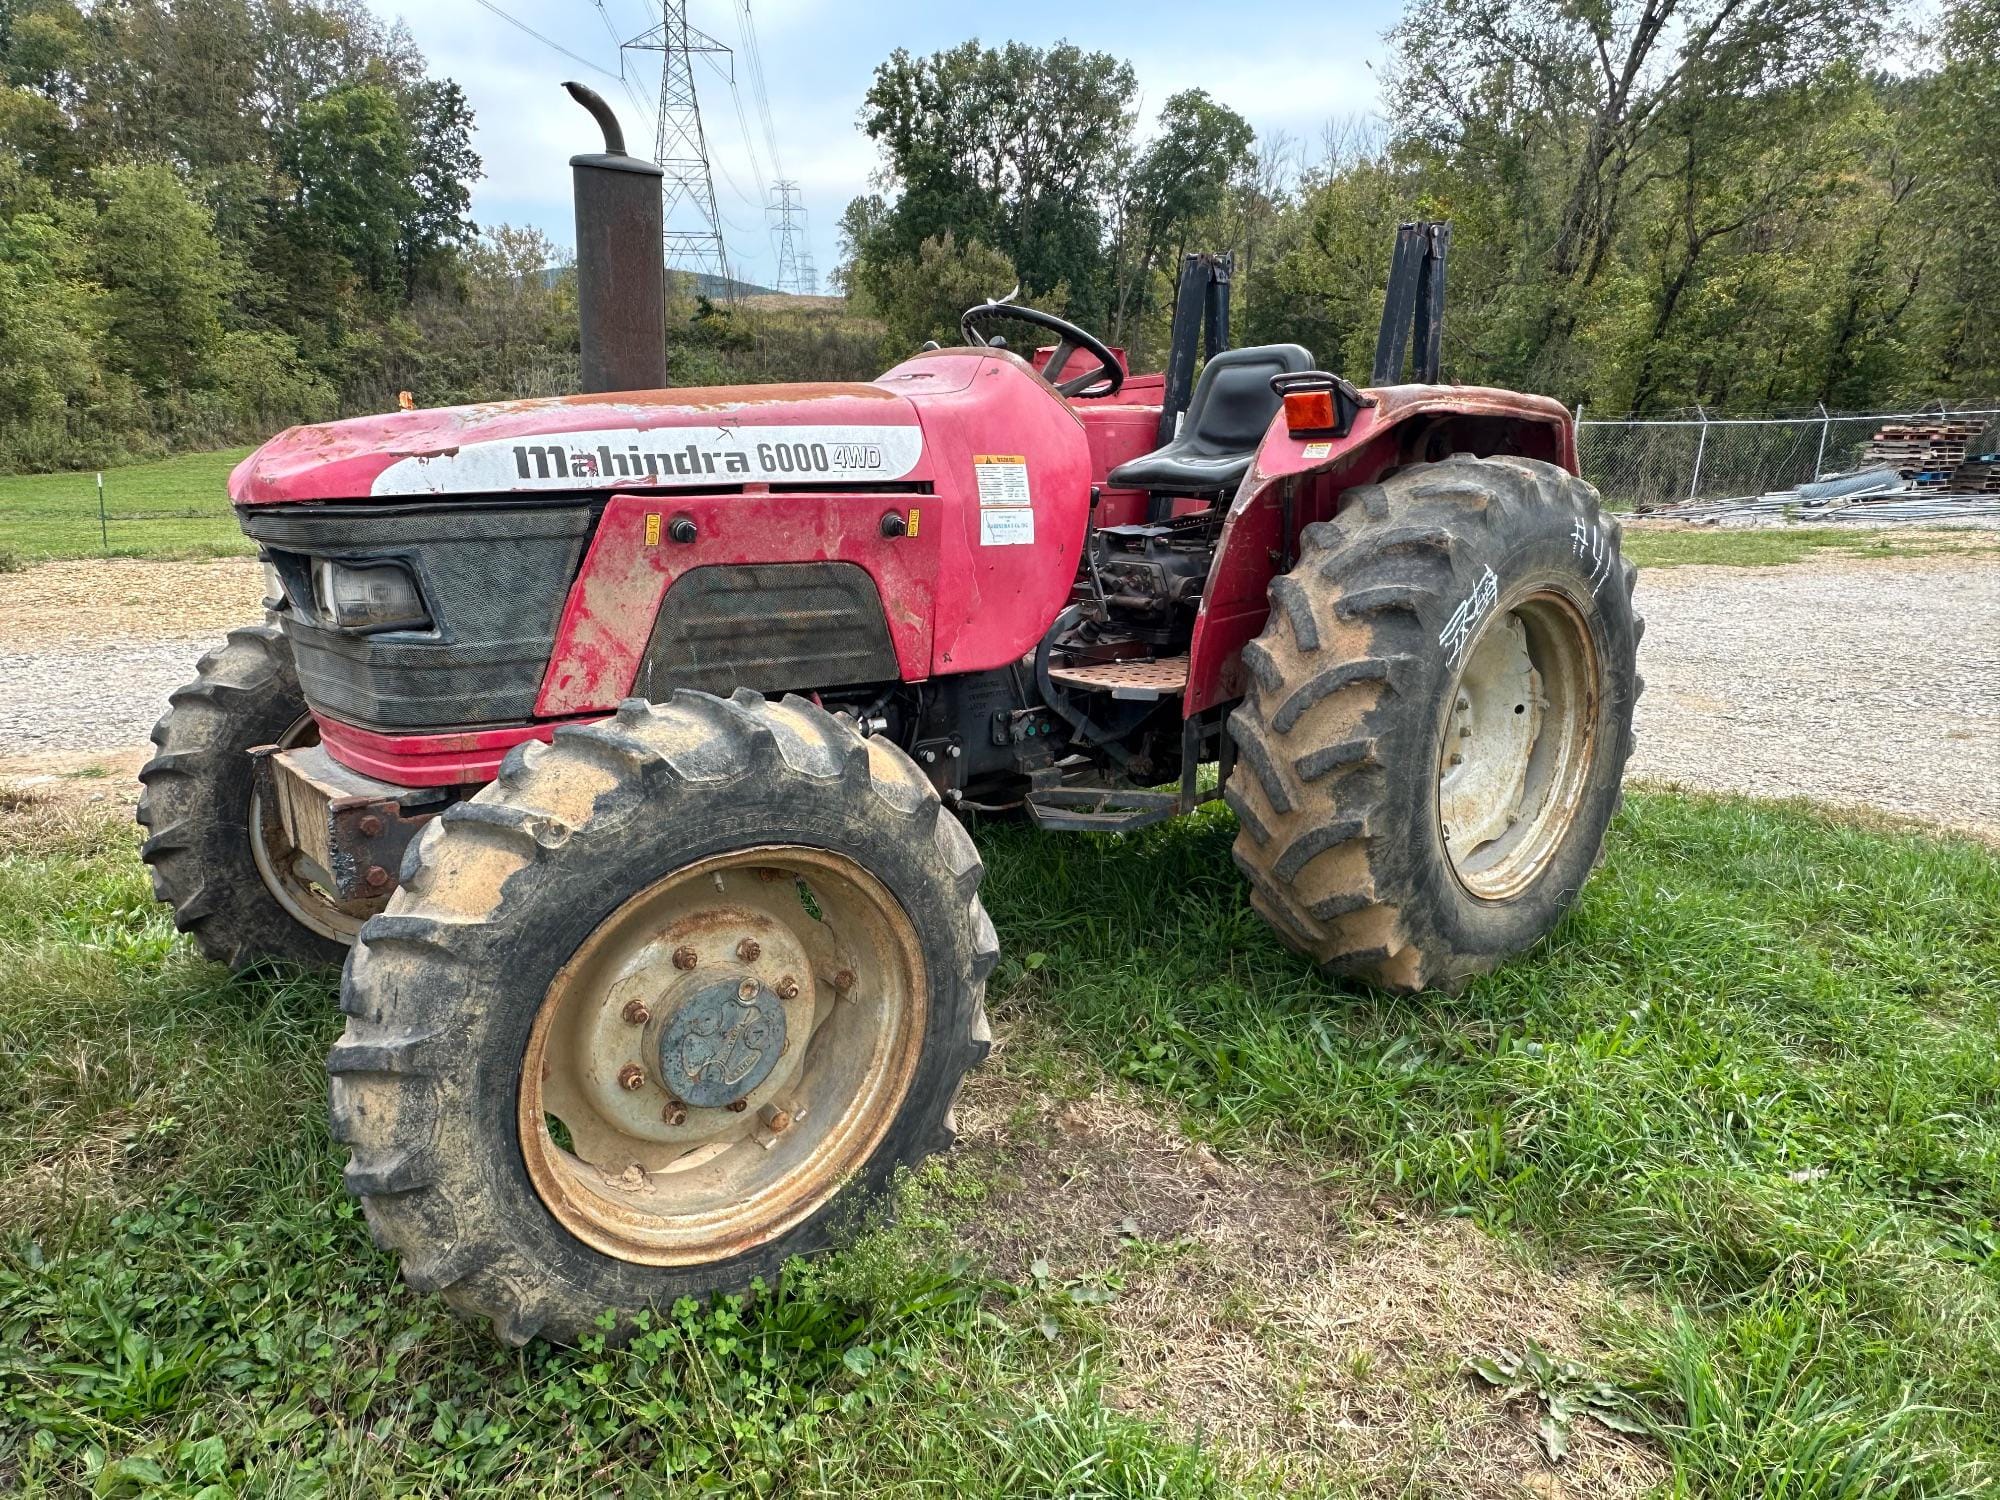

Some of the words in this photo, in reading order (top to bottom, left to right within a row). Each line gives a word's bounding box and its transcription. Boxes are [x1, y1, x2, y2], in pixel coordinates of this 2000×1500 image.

[513, 443, 750, 479] Mahindra
[757, 443, 828, 473] 6000
[833, 443, 883, 470] 4WD
